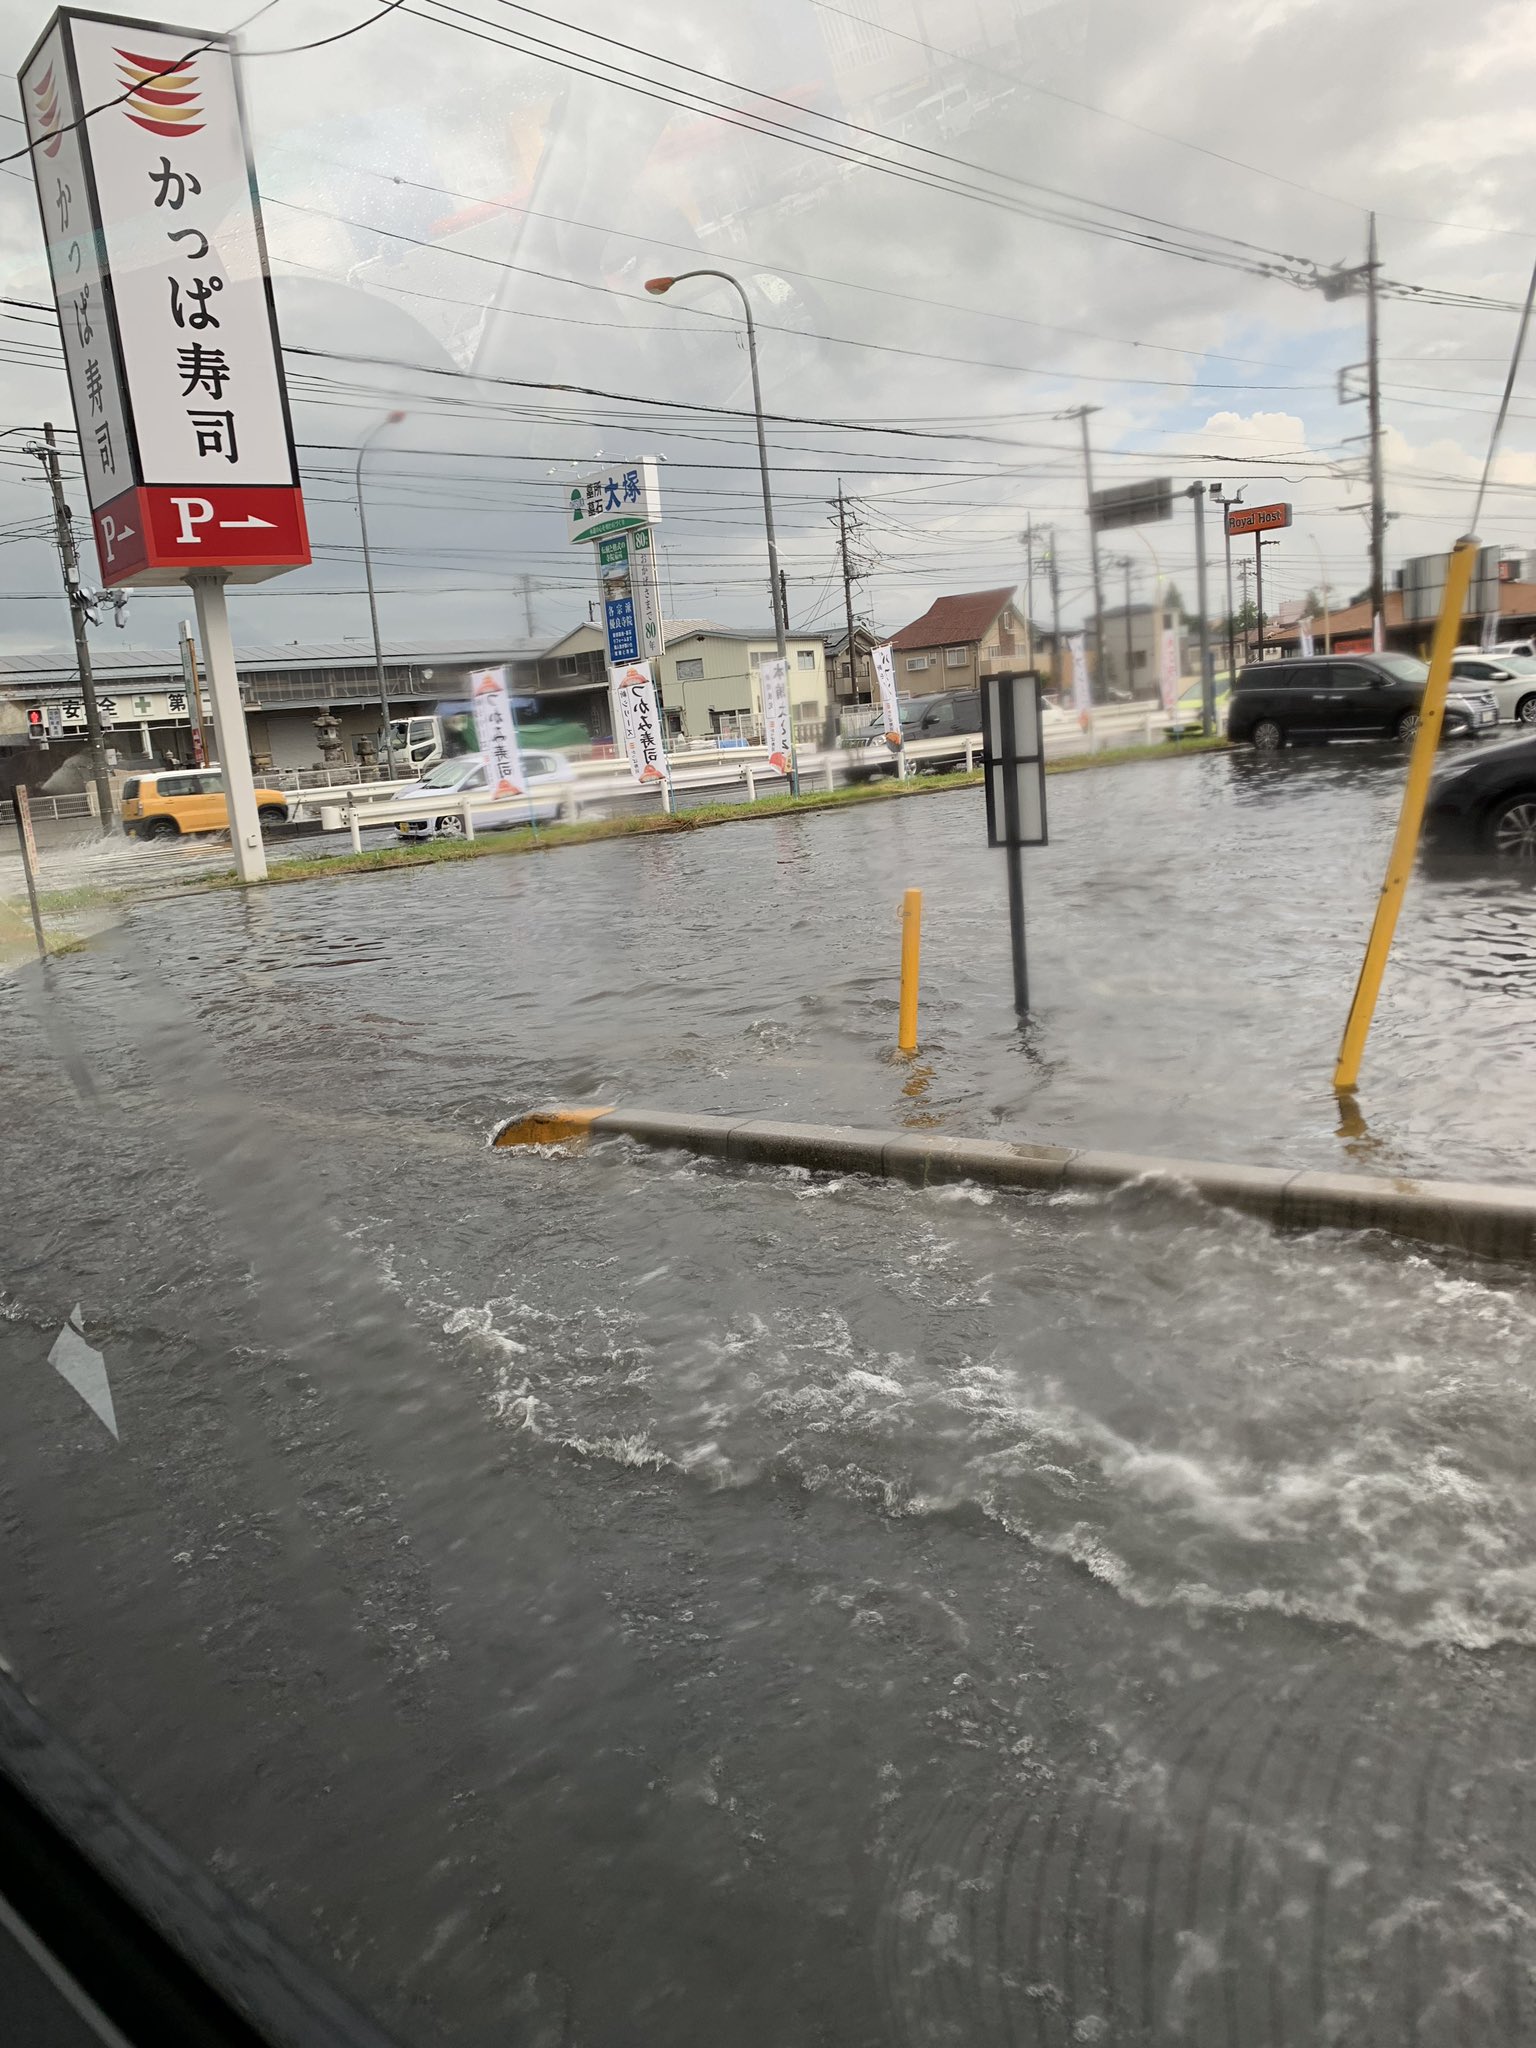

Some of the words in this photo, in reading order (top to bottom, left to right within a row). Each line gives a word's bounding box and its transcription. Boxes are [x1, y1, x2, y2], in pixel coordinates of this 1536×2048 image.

[55, 177, 116, 476] かっぱ寿司
[148, 156, 239, 465] かっぱ寿司
[587, 499, 604, 517] 墓石
[604, 470, 641, 511] 大塚
[101, 515, 115, 563] P
[170, 497, 214, 544] P
[1229, 513, 1255, 528] Royal
[1258, 511, 1281, 524] Host
[62, 697, 117, 719] 安全
